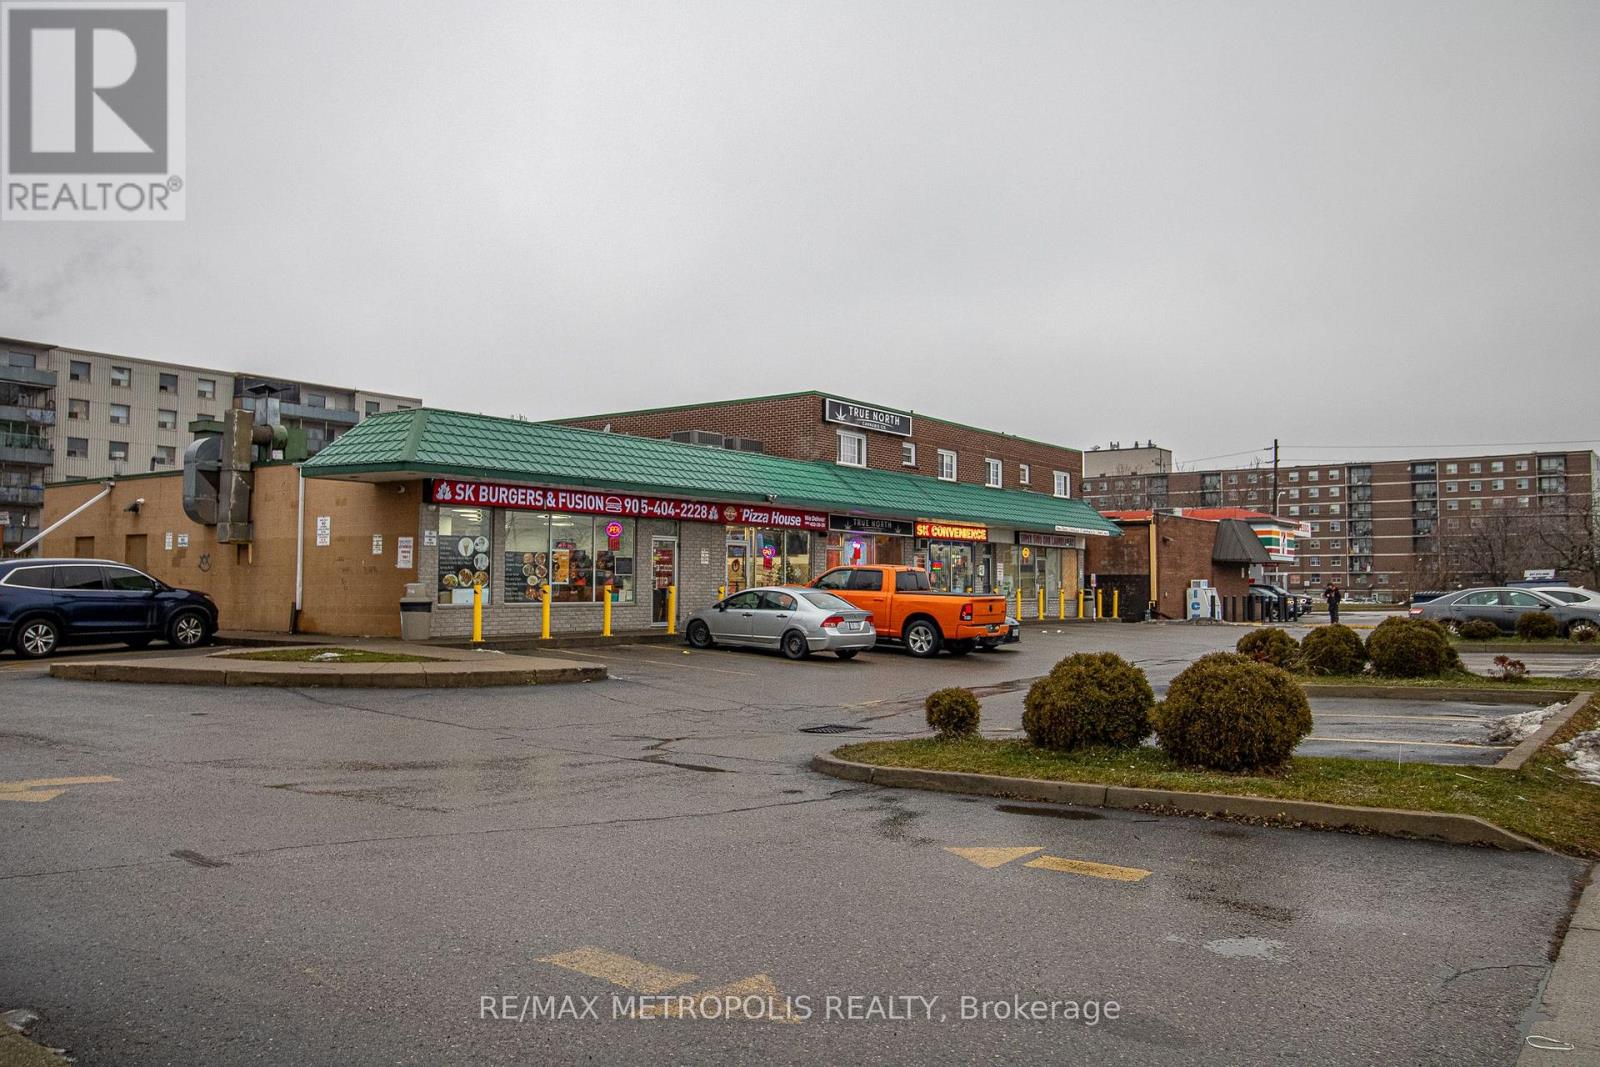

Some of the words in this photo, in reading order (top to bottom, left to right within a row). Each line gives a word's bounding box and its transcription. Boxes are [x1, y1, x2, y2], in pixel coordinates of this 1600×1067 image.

[848, 406, 870, 419] TRUE
[872, 411, 900, 426] NORTH
[455, 483, 475, 501] SK
[479, 486, 544, 506] BURGERS
[546, 490, 556, 508] &
[558, 491, 604, 511] FUSION
[624, 498, 708, 519] 905-404-2228
[742, 508, 769, 523] Pizza
[771, 511, 802, 526] House
[916, 524, 930, 537] SK
[931, 525, 987, 540] CONVENIENCE
